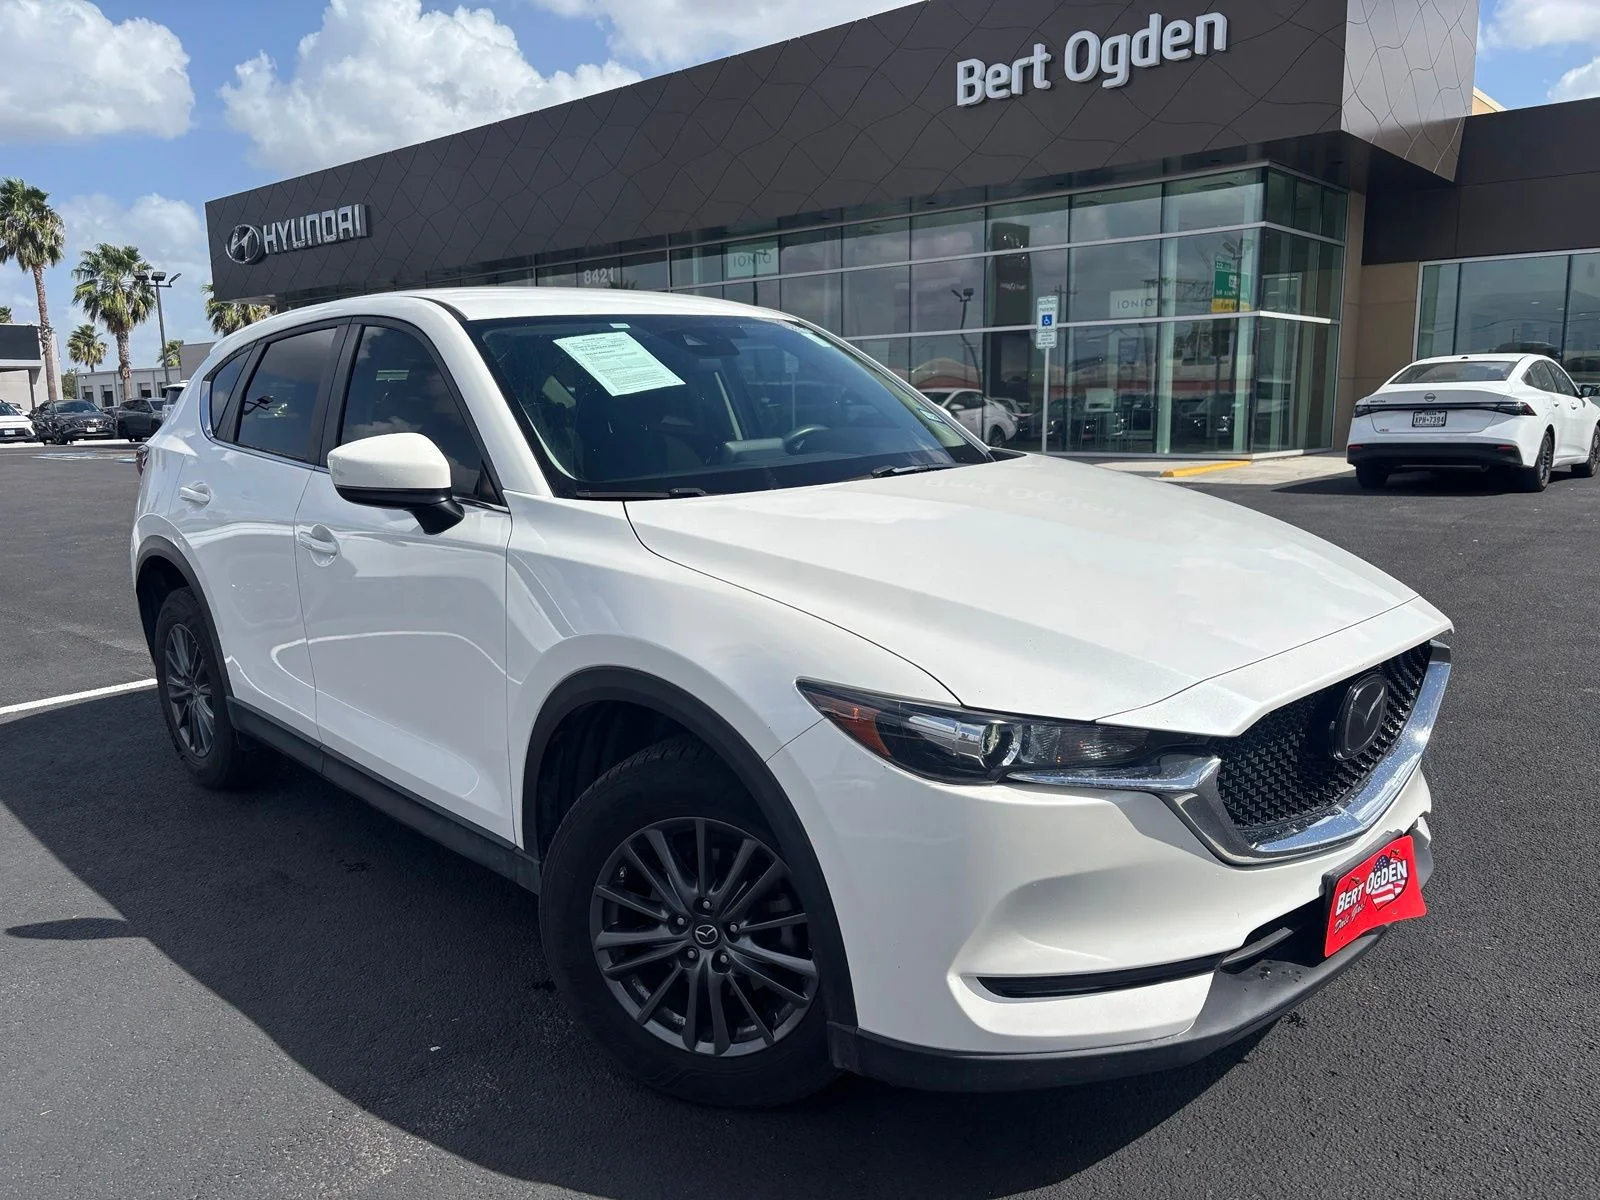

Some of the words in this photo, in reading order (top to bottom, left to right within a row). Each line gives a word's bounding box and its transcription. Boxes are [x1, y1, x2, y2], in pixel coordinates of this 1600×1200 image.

[957, 43, 1052, 106] Bert
[1064, 12, 1228, 89] Ogden
[263, 203, 368, 254] HYUNDAI
[583, 266, 615, 285] 8421
[1335, 882, 1366, 917] BERT
[1365, 859, 1408, 895] OGDEN
